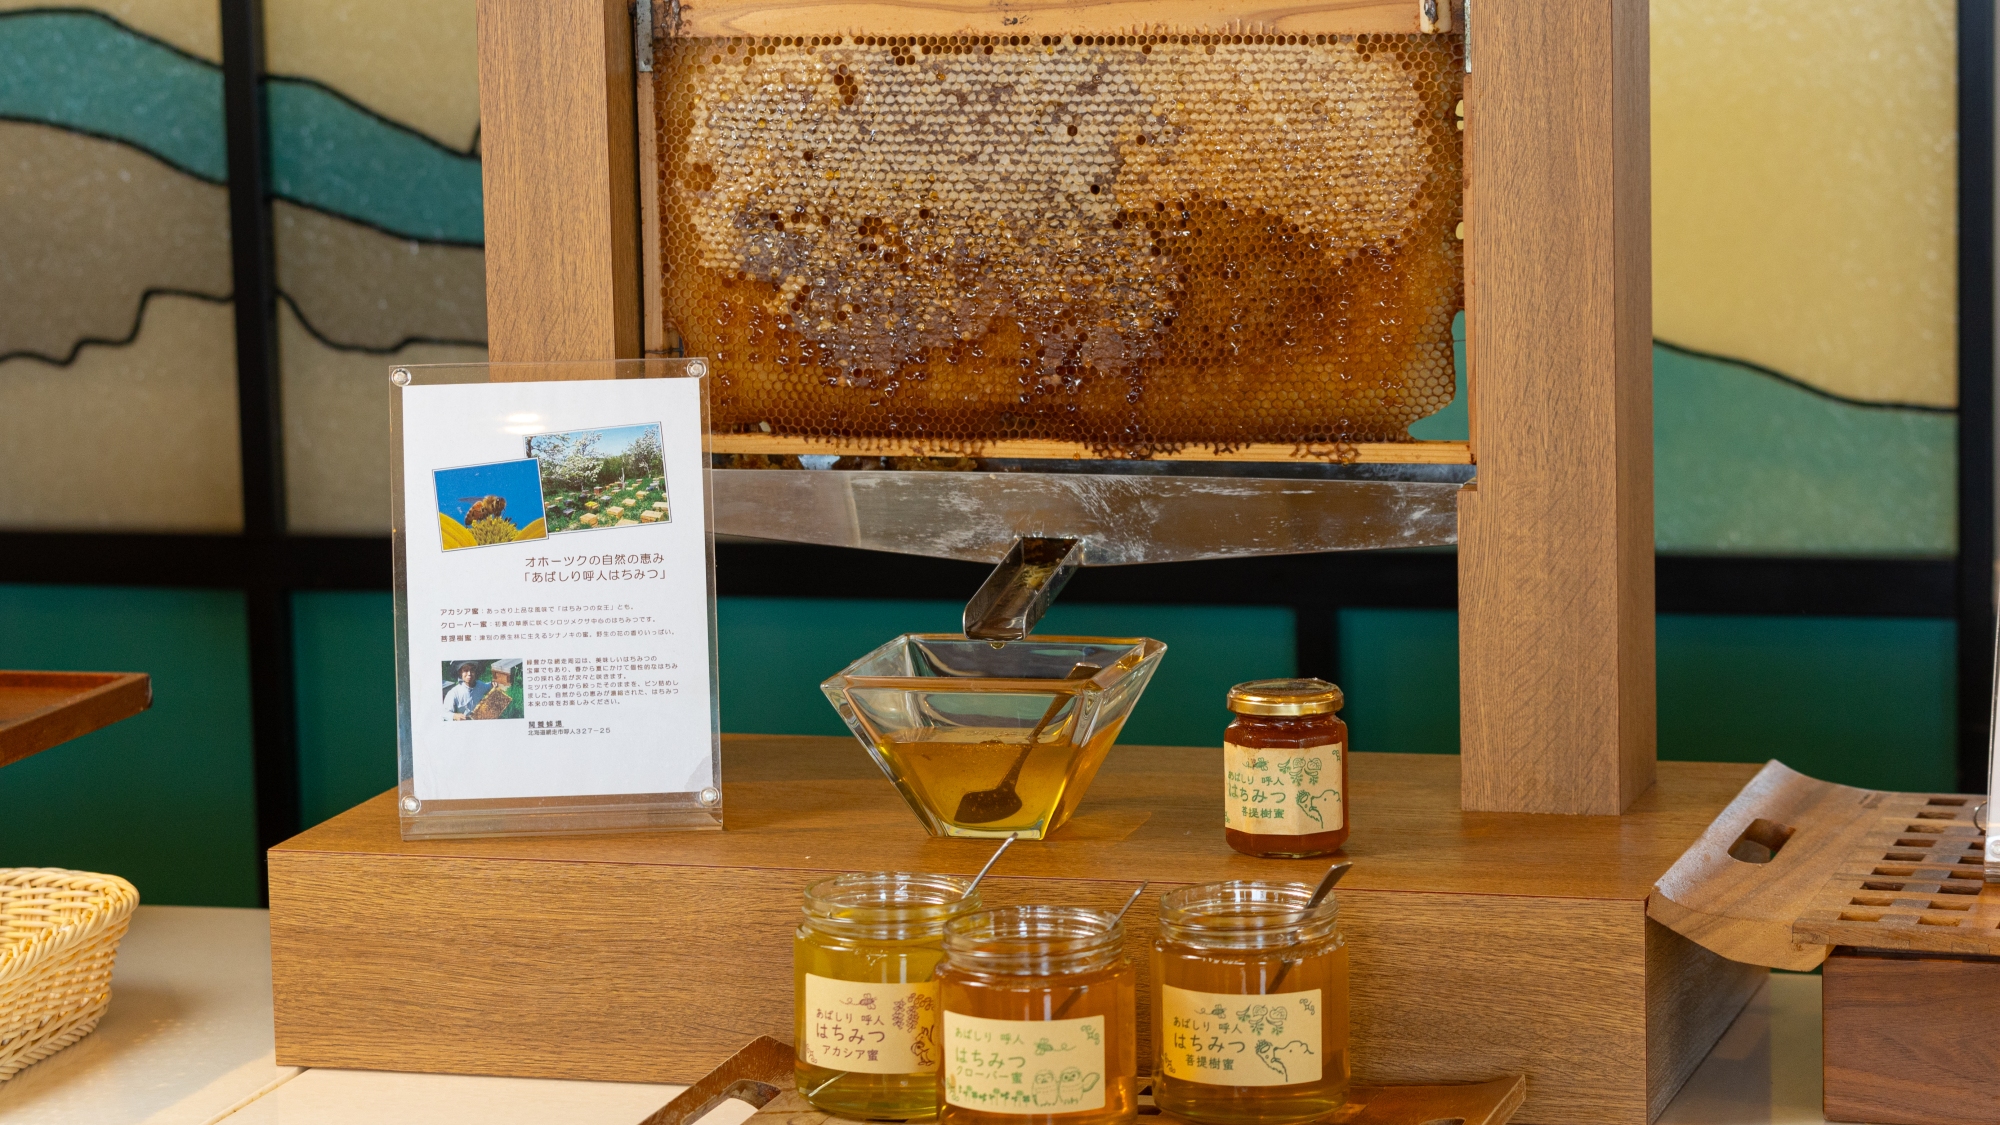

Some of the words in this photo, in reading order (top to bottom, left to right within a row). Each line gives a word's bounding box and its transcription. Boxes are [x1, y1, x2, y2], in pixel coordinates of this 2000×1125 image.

[525, 552, 665, 568] オホーツクの自然の恵み
[524, 569, 666, 583] 「あばしり呼人はちみつ」
[1228, 770, 1254, 785] あばしり
[1261, 775, 1285, 787] 呼人
[1227, 782, 1286, 804] はちみつ
[1241, 806, 1285, 820] 菩提樹蜜
[816, 1008, 853, 1023] あばしり
[861, 1014, 885, 1026] 呼人
[1173, 1015, 1210, 1032] あばしり
[1218, 1023, 1243, 1035] 呼人
[816, 1022, 886, 1045] はちみつ
[955, 1027, 992, 1043] あばしり
[1000, 1032, 1025, 1046] 呼人
[1173, 1032, 1246, 1054] はちみつ
[822, 1044, 879, 1062] アカシア蜜
[955, 1046, 1026, 1070] はちみつ
[1185, 1053, 1235, 1071] 菩提樹蜜
[956, 1066, 1023, 1085] クローバー蜜
